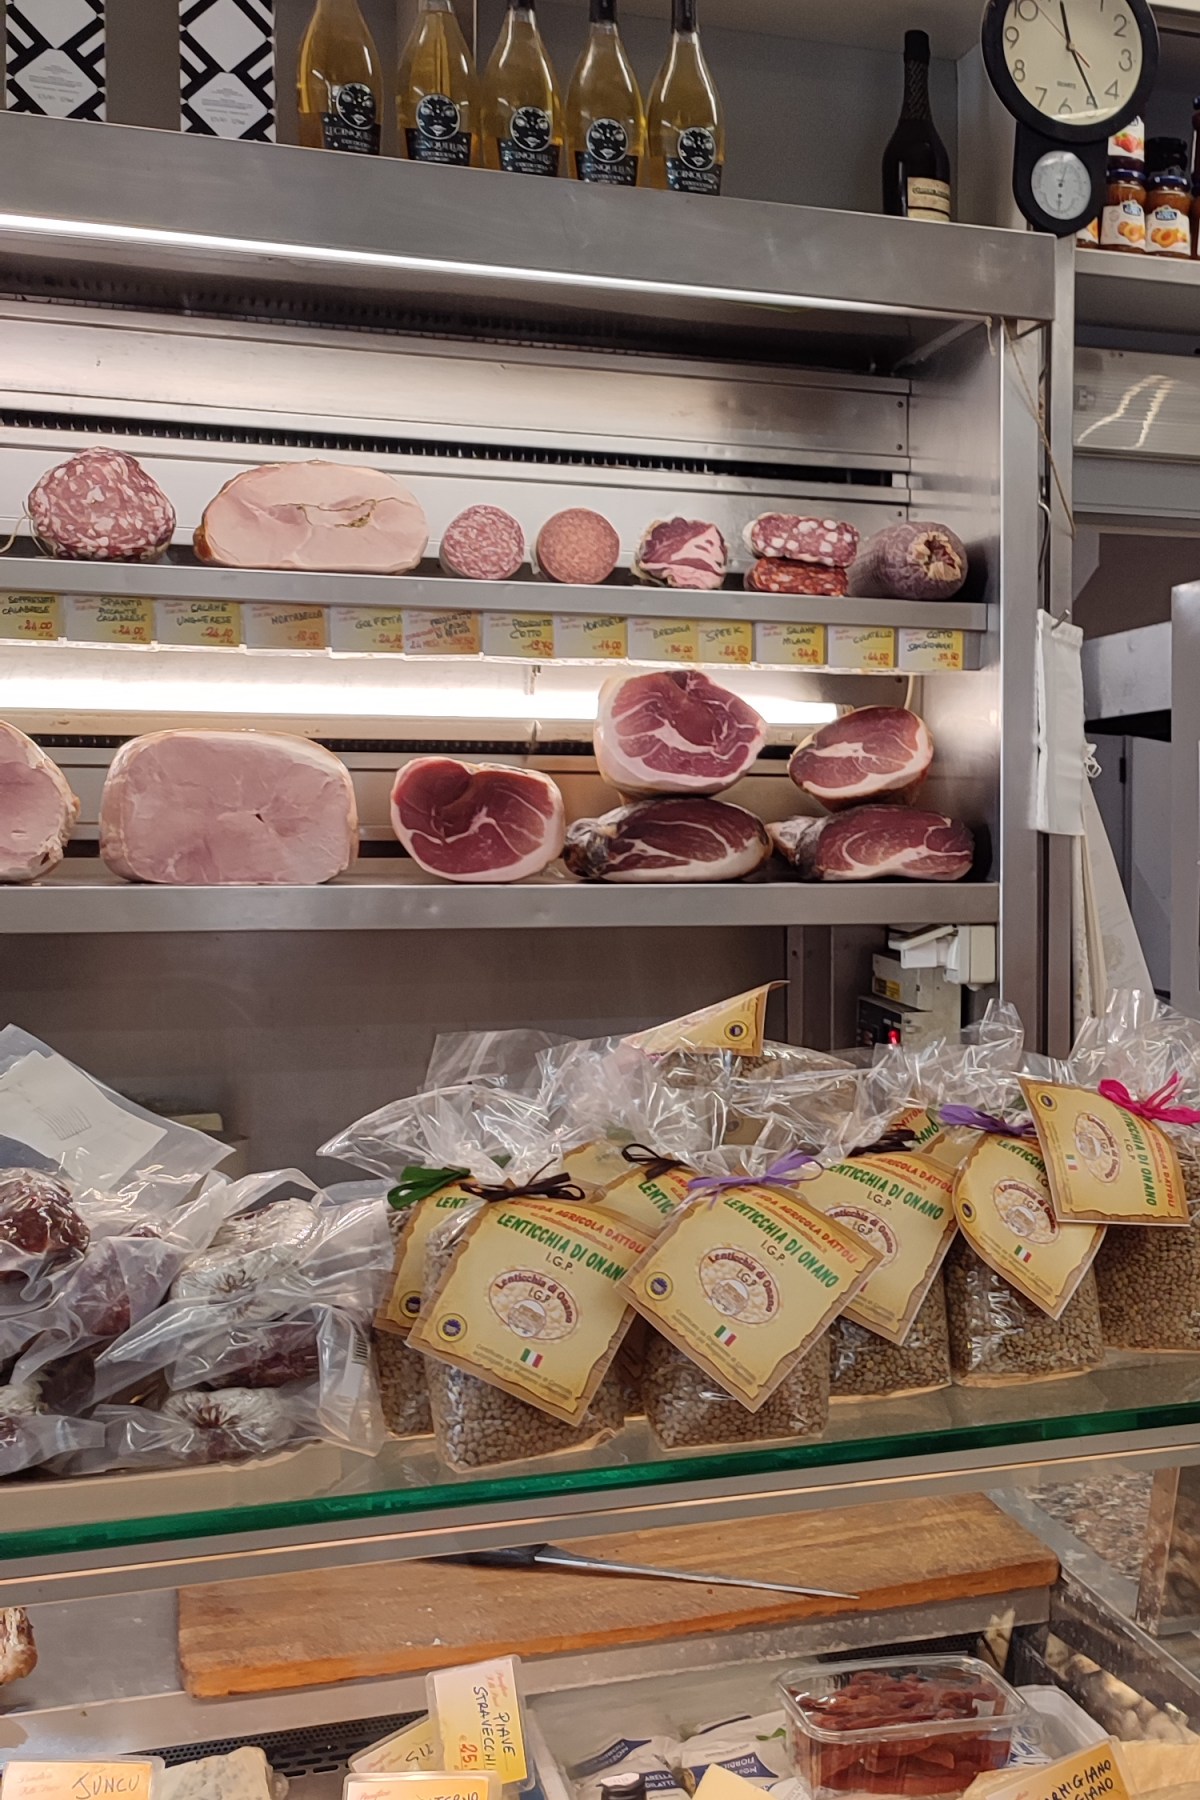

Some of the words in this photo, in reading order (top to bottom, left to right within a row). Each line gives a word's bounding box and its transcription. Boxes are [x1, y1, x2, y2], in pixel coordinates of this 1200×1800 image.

[1004, 26, 1020, 49] 9
[1114, 14, 1128, 37] 2
[1013, 59, 1026, 83] 8
[1118, 49, 1133, 72] 3
[1035, 86, 1048, 108] 7
[1104, 80, 1120, 99] 4
[1058, 98, 1073, 115] 6
[190, 603, 230, 613] SALAME
[271, 610, 323, 625] MORTADELLA
[786, 626, 816, 635] SALAME
[852, 630, 893, 644] CULATELLO
[927, 630, 953, 639] COTTO
[996, 1139, 1047, 1176] LENTICCH
[1137, 1154, 1149, 1166] DI
[638, 1180, 675, 1215] LENTIC
[828, 1163, 889, 1193] ENTICCHIA
[888, 1184, 904, 1200] DI
[903, 1191, 945, 1221] ONANO
[1141, 1167, 1158, 1207] ONANO
[866, 1190, 893, 1211] I.G.P.
[555, 1209, 605, 1234] AGRICOLA
[779, 1204, 823, 1236] AGRICOLA
[829, 1208, 869, 1223] enticchia
[869, 1217, 879, 1227] di
[879, 1225, 893, 1254] Onano
[497, 1213, 571, 1254] LENTICCHIA
[569, 1243, 589, 1262] DI
[723, 1196, 788, 1244] LENTICCHIA
[785, 1237, 800, 1254] DI
[797, 1251, 840, 1289] ONANO
[545, 1251, 574, 1275] I.G.P.
[760, 1238, 786, 1267] I.G.P.
[707, 1250, 757, 1273] Lenticchia
[755, 1266, 766, 1280] di
[763, 1277, 775, 1313] Onano
[495, 1272, 547, 1290] Lenticchia
[547, 1283, 559, 1294] di
[556, 1291, 573, 1324] Onano
[528, 1286, 552, 1307] I.G.P.
[473, 1685, 496, 1770] STRAVECCHI
[494, 1712, 516, 1758] PIAVE
[72, 1771, 140, 1800] JUNCU
